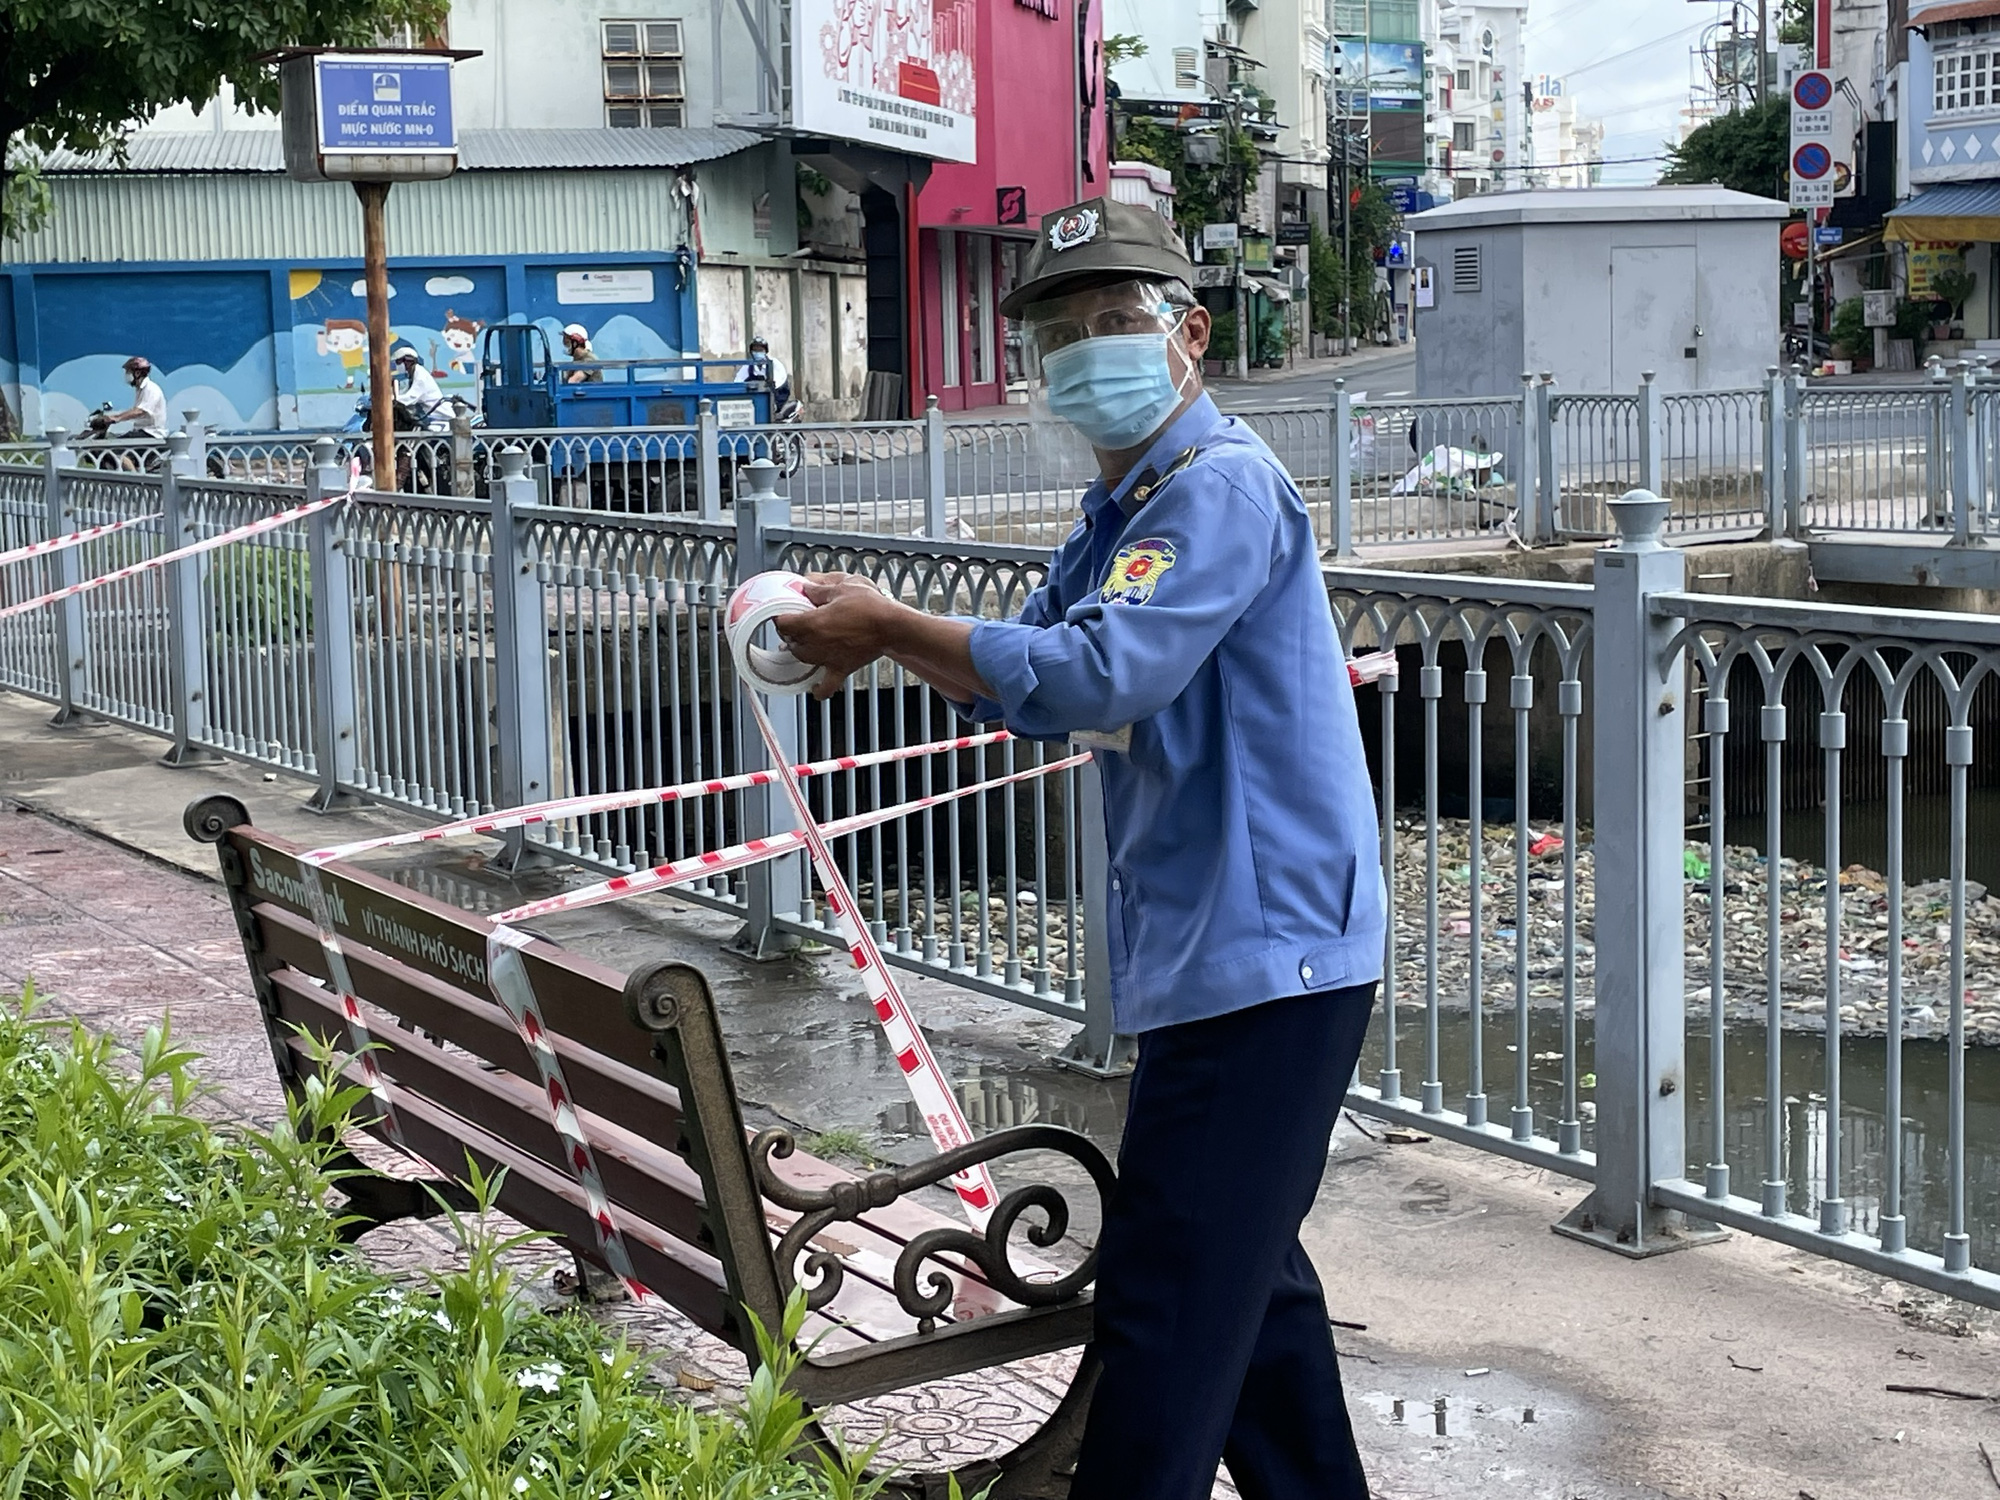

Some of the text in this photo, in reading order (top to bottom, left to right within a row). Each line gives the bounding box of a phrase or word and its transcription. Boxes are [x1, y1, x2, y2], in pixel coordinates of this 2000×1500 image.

[371, 104, 402, 117] QUAN
[1540, 75, 1561, 96] ila
[341, 122, 367, 137] MỰC
[370, 121, 402, 135] NƯỚC
[1492, 70, 1504, 192] KARAOK
[250, 847, 349, 926] Sacomnk
[361, 905, 487, 985] VÌ THÀNH PHỐ SẠCH
